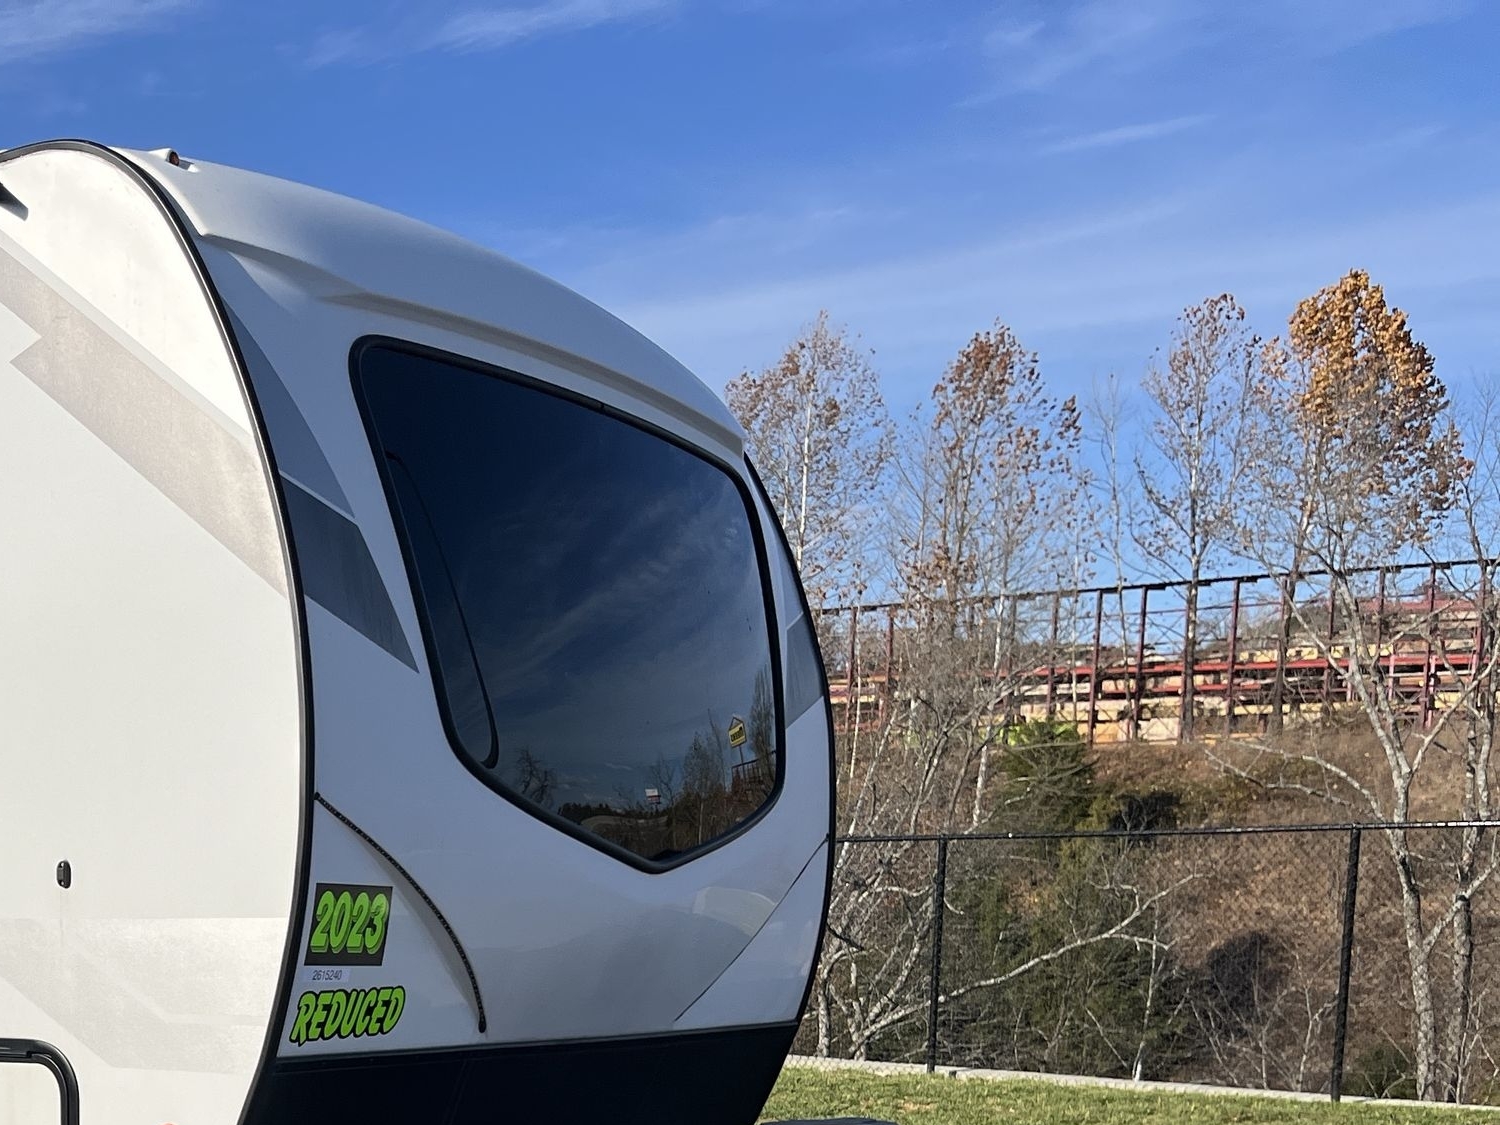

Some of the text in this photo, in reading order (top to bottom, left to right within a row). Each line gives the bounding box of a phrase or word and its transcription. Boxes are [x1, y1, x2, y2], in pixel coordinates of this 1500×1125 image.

[309, 890, 389, 955] 2023
[311, 969, 343, 981] 2615240
[289, 985, 406, 1047] REDUCED
